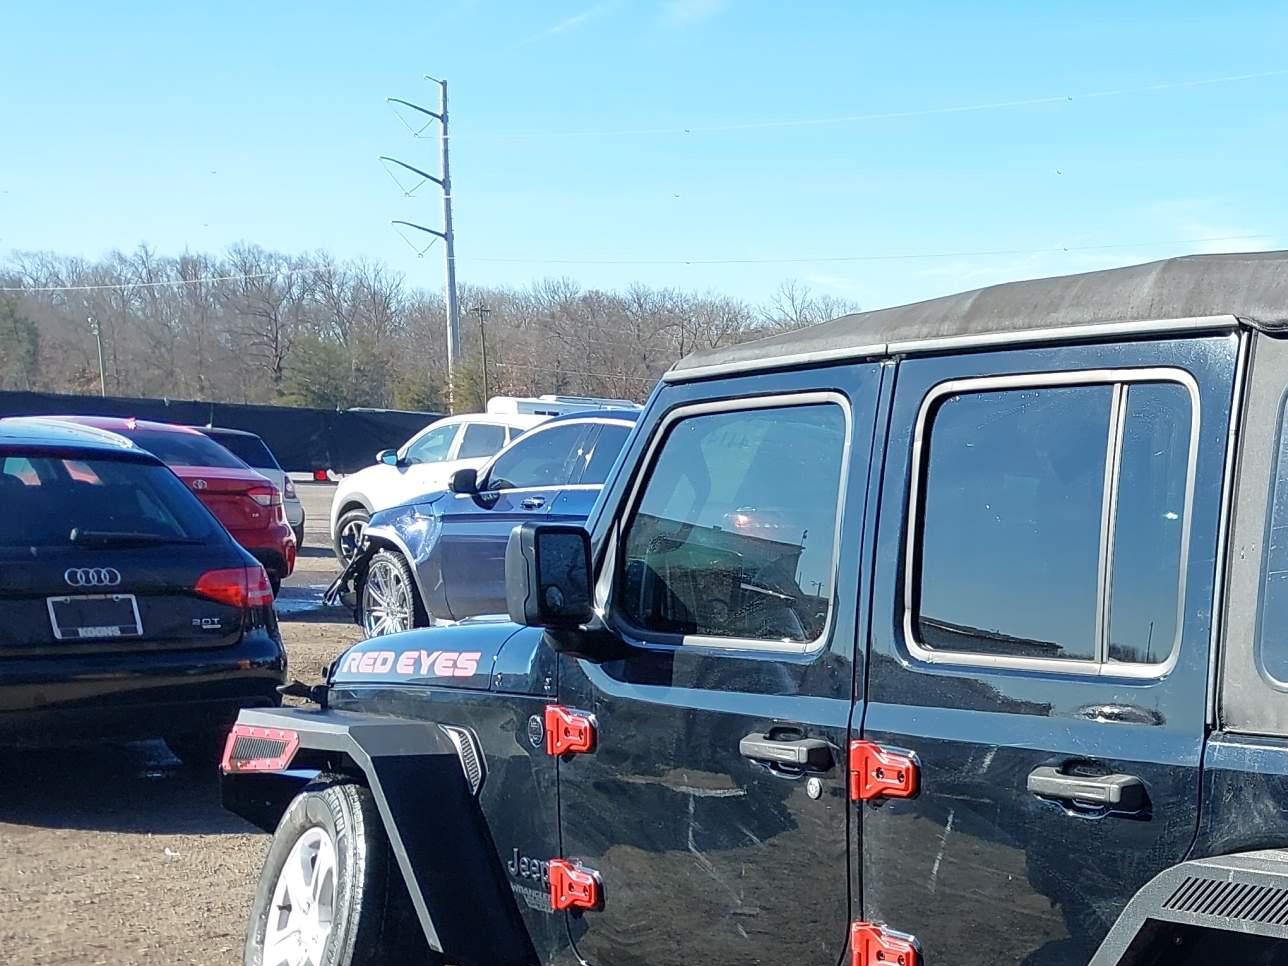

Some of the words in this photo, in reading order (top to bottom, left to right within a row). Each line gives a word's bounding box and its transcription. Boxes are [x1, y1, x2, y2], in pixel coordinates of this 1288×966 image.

[78, 625, 121, 638] KOONS
[341, 651, 396, 674] RED
[396, 649, 482, 677] EYES
